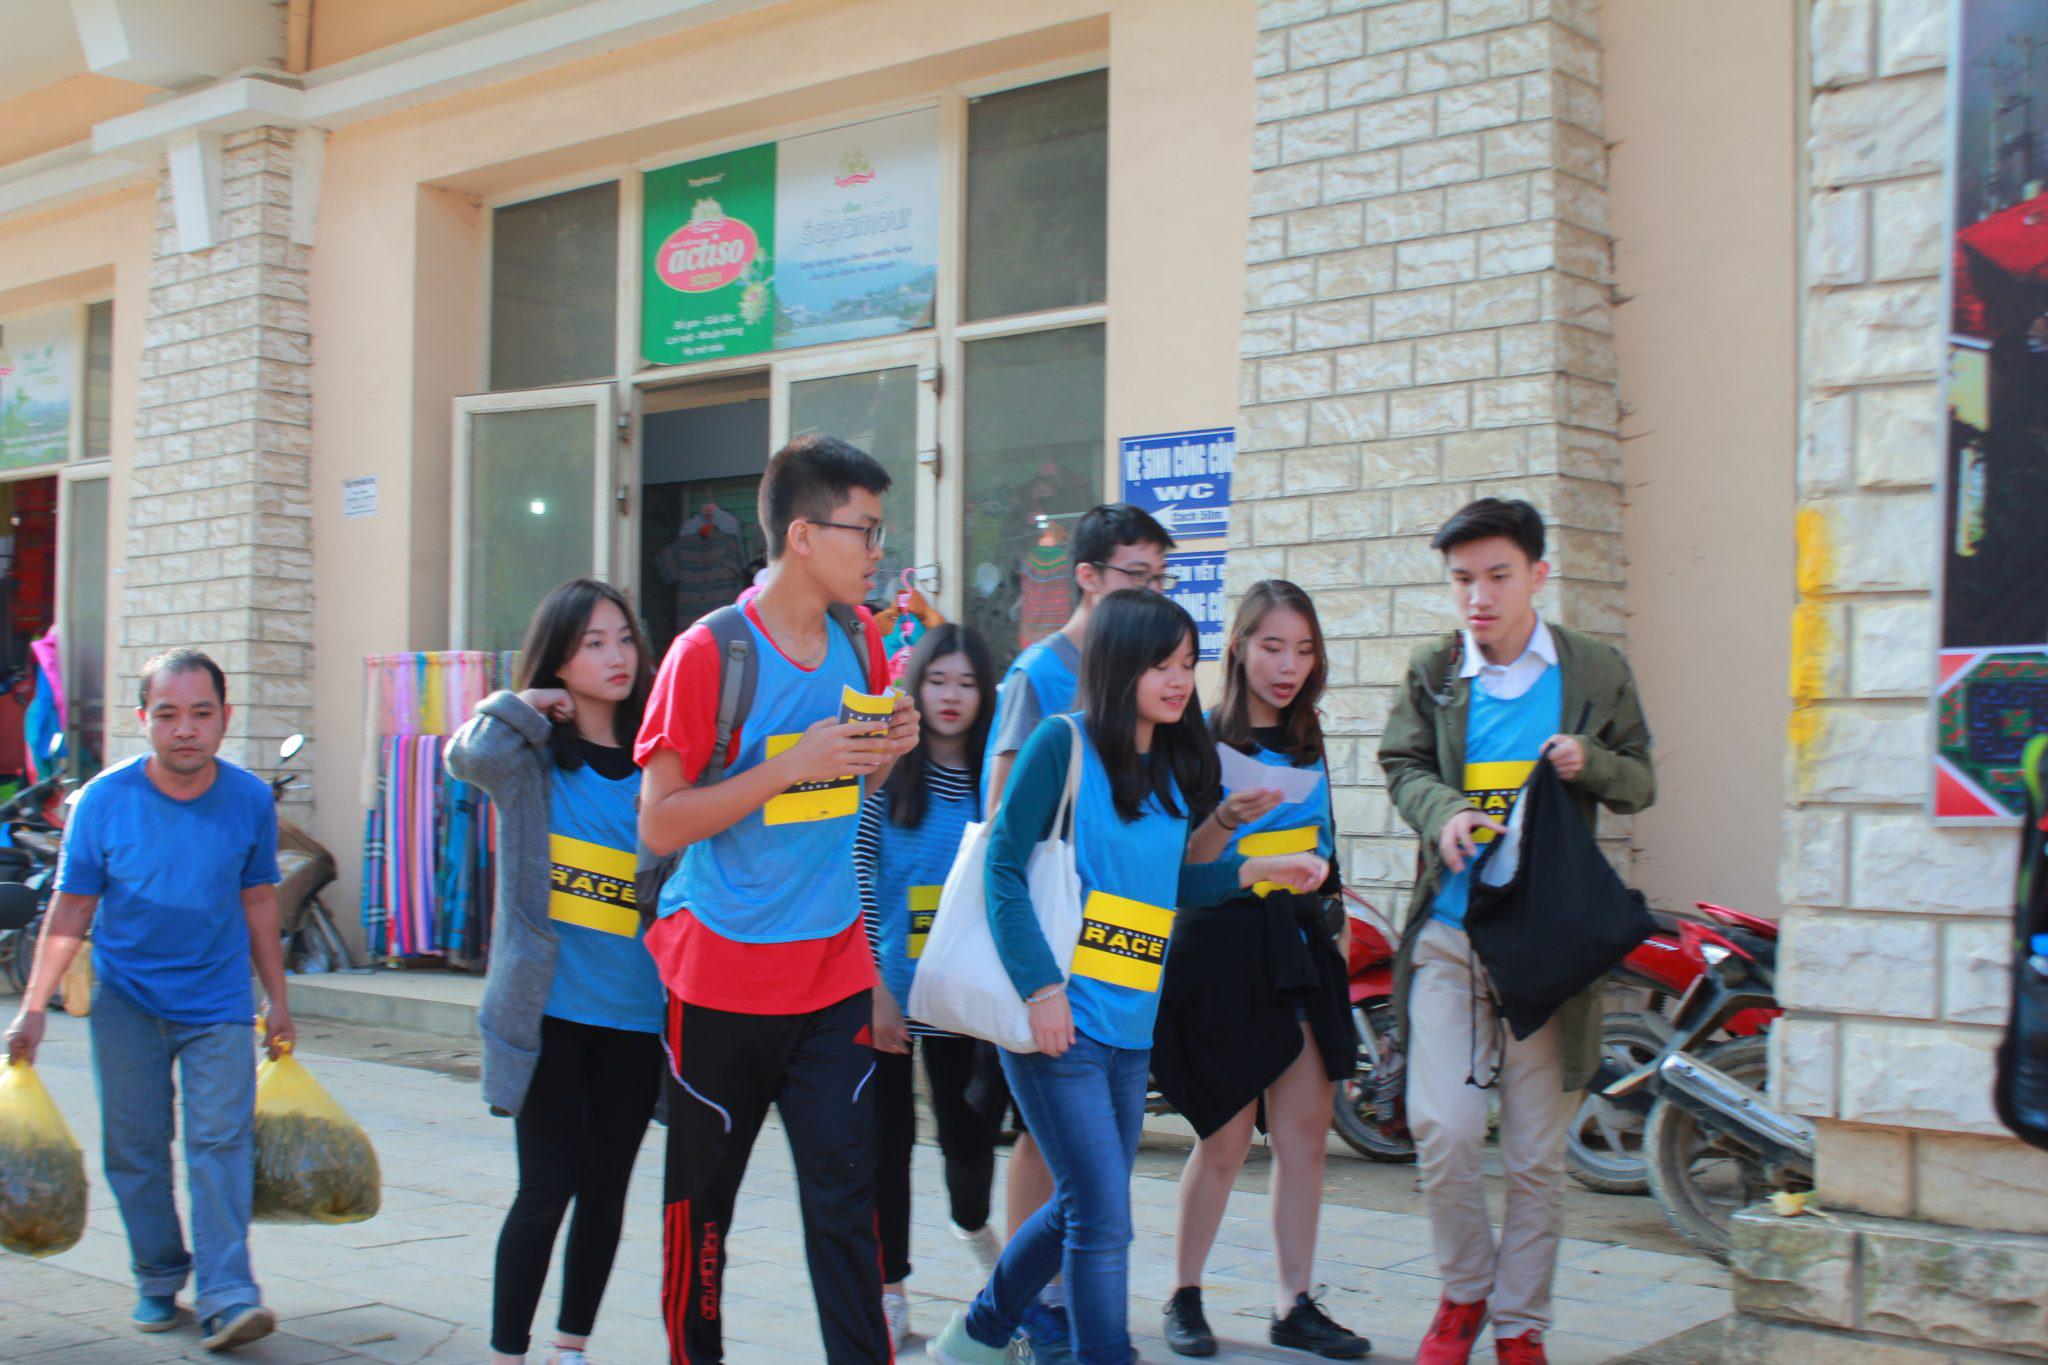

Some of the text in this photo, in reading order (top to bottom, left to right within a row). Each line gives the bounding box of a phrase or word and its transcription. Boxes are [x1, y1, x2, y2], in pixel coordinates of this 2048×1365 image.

[668, 233, 746, 274] actiso
[1152, 483, 1215, 502] WC
[550, 869, 638, 904] RACE
[1084, 926, 1164, 958] RACE
